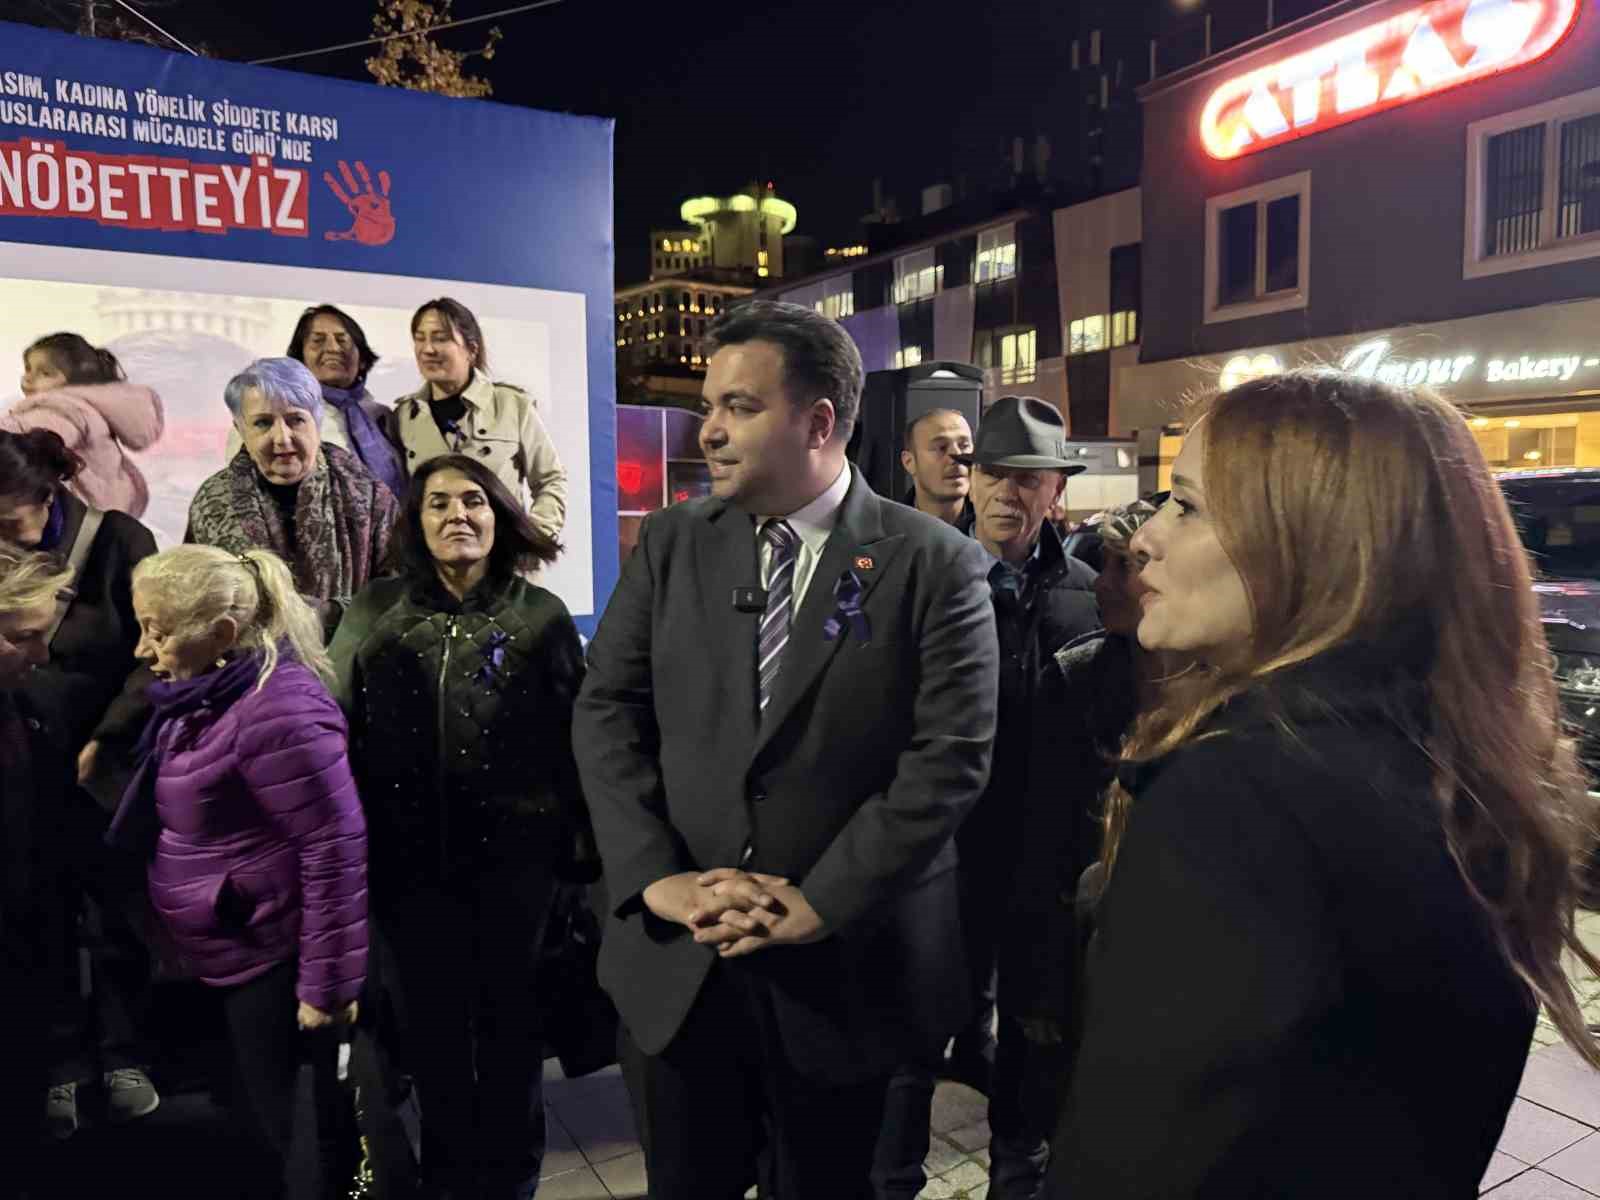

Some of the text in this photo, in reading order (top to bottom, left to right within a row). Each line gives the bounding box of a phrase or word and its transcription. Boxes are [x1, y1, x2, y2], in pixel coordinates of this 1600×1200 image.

[1232, 0, 1546, 150] ATLAS
[0, 100, 127, 139] USLARARASI
[133, 117, 227, 152] MÜCADELE
[55, 79, 128, 112] KADINA
[134, 88, 207, 122] YÖNELİK
[212, 99, 282, 133] ŞİDDETE
[286, 111, 338, 141] KARŞI
[0, 142, 305, 230] NÖBETTEYİZ
[1342, 340, 1580, 385] Amour Bakery
